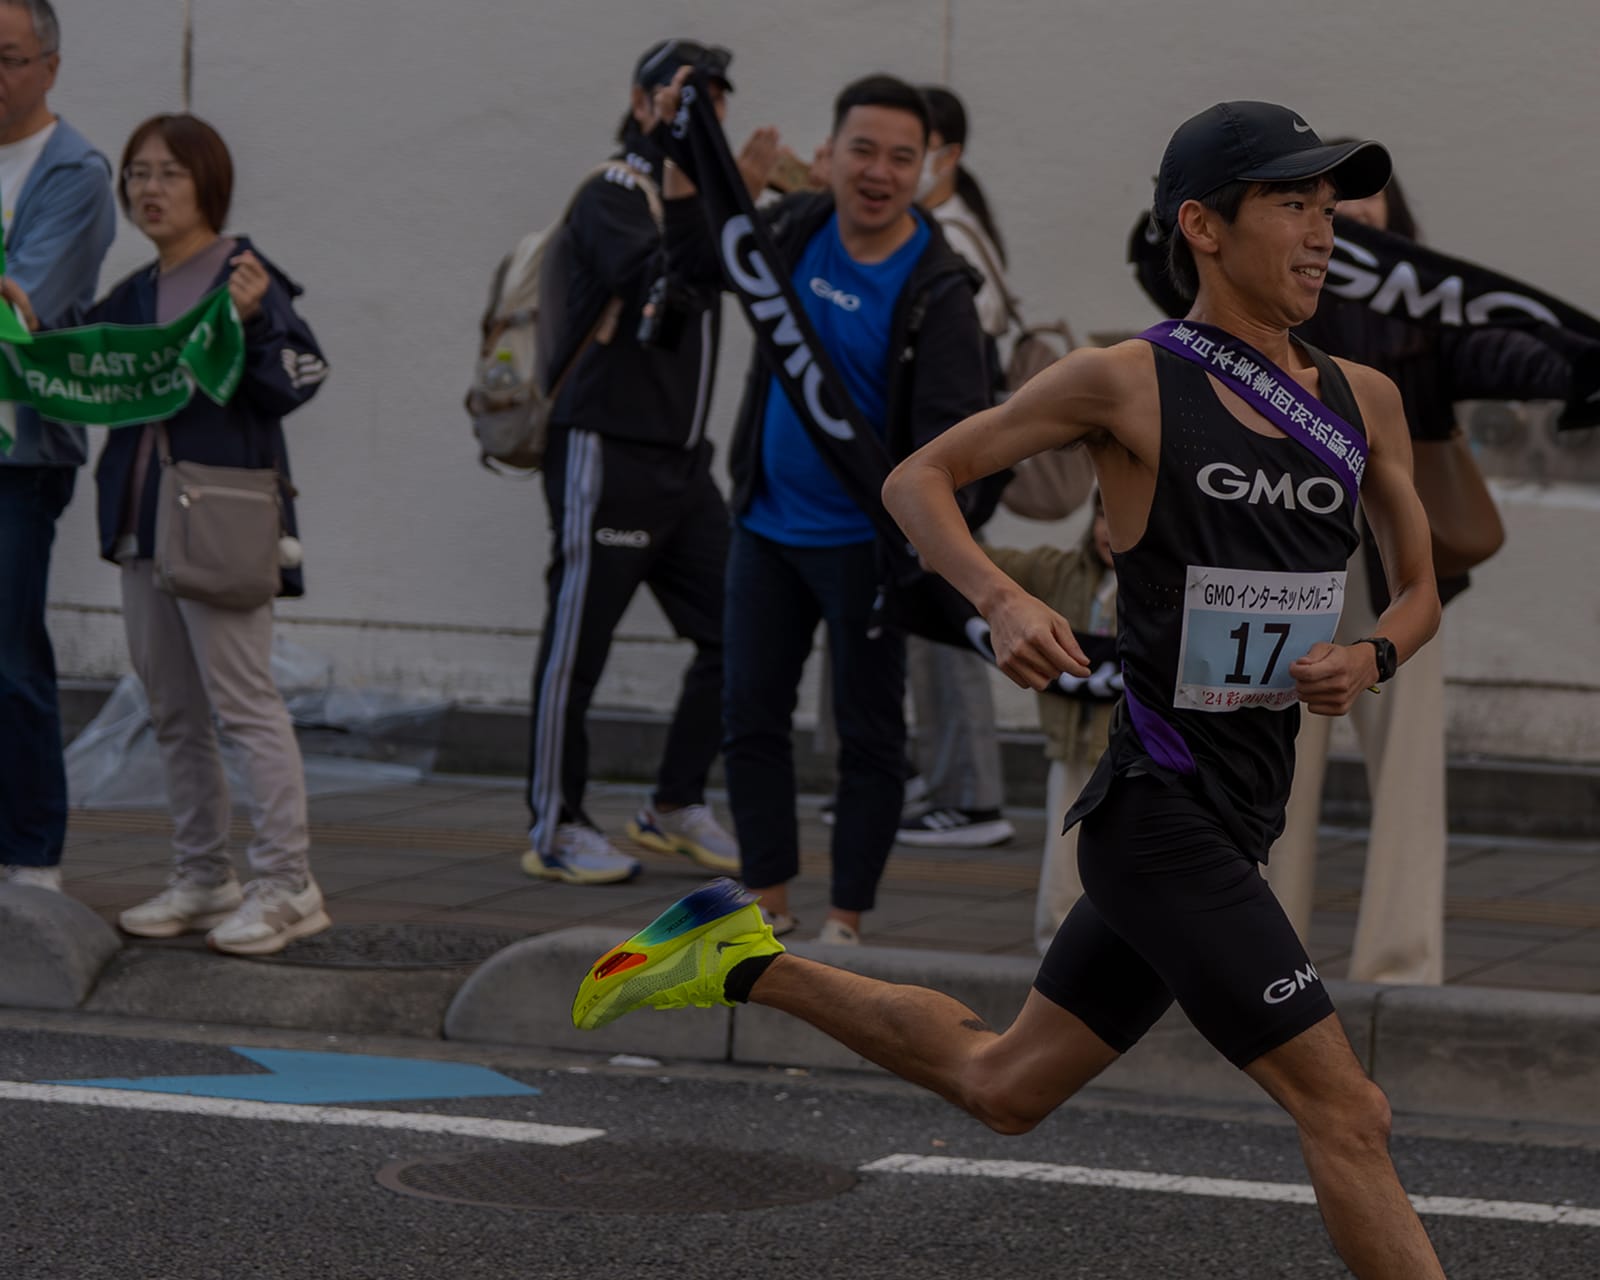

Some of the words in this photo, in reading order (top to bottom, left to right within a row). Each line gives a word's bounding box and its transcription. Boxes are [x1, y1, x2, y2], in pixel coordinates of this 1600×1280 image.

[809, 277, 862, 312] GMO
[67, 352, 137, 377] EAST
[1196, 462, 1344, 514] GMO
[594, 528, 651, 549] GMO
[1225, 622, 1291, 685] 17
[1263, 962, 1319, 1005] GM
